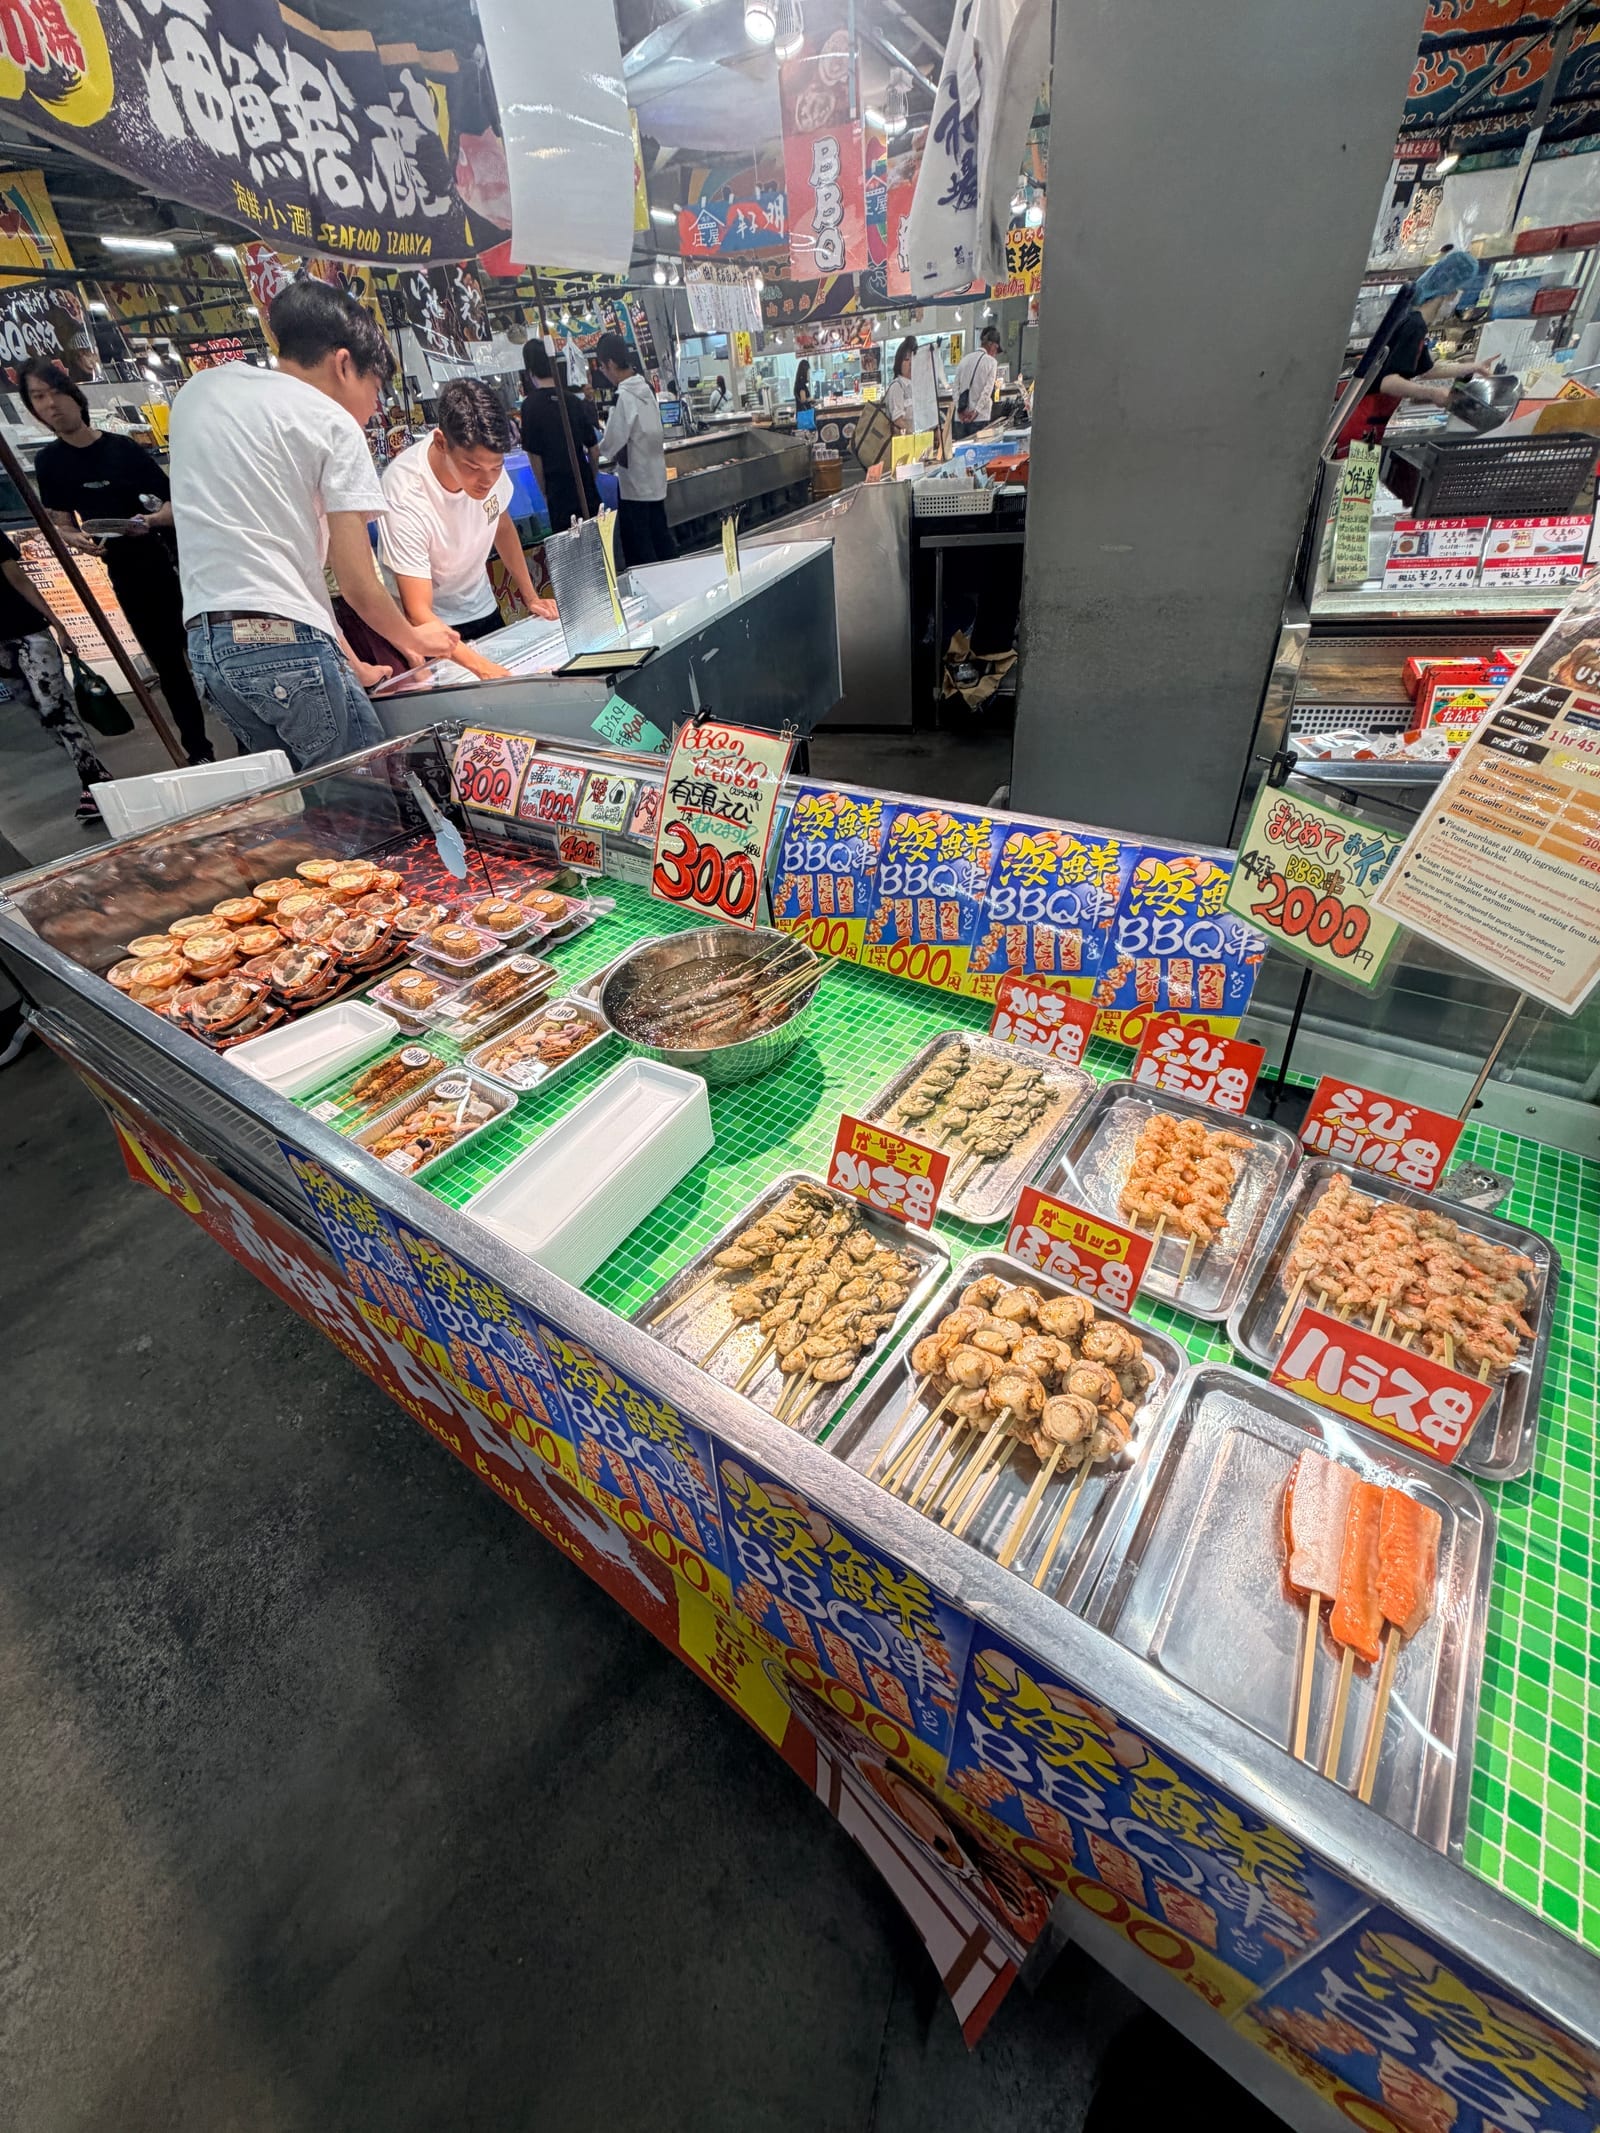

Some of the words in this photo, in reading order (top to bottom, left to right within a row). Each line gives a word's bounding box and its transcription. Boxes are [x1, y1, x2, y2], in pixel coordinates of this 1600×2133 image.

[809, 135, 845, 272] BBQ
[318, 223, 381, 252] SEAFOOD
[386, 231, 432, 256] IZAKAYA
[1542, 695, 1564, 708] hours
[682, 728, 744, 756] BBQの
[1500, 715, 1516, 727] time
[1518, 720, 1539, 734] limit
[1548, 730, 1559, 741] 1
[1560, 734, 1576, 747] hr
[1577, 739, 1597, 753] 45
[1513, 742, 1528, 755] list
[669, 776, 760, 824] 有頭えび
[1468, 773, 1489, 785] child
[791, 799, 883, 841] 海鮮
[1451, 802, 1473, 816] infant
[888, 817, 993, 862] 海鮮
[1268, 804, 1346, 860] まとめて
[1444, 819, 1469, 834] Please
[1466, 829, 1500, 848] purchase
[1500, 843, 1513, 853] all
[1511, 848, 1533, 863] BBQ
[1531, 856, 1579, 882] ingredients
[1448, 831, 1480, 849] Toretore
[783, 840, 878, 876] BBQ串
[1000, 838, 1120, 887] 海鮮
[1285, 854, 1346, 896] BBQ串
[799, 877, 813, 910] えび
[818, 874, 834, 913] ほたて
[836, 877, 854, 912] かき
[856, 880, 868, 904] など
[879, 862, 988, 899] BBQ串
[1420, 855, 1442, 869] Usage
[1440, 864, 1456, 876] time
[1467, 877, 1484, 889] hour
[1483, 885, 1497, 895] and
[1497, 891, 1507, 900] 45
[1537, 910, 1568, 930] starting
[1568, 924, 1587, 939] from
[1441, 876, 1453, 884] you
[1453, 880, 1483, 898] complete
[895, 900, 912, 936] えび
[918, 899, 936, 940] ほたて
[939, 903, 960, 940] かき
[962, 906, 974, 931] など
[987, 887, 1116, 931] BBQ串
[1494, 916, 1525, 936] purchasing
[1007, 928, 1026, 965] えび
[1034, 925, 1054, 970] ほたて
[1061, 929, 1082, 970] かき
[1114, 915, 1265, 965] BBQ串
[1136, 960, 1160, 1001] えび
[1199, 964, 1225, 1008] かき
[1230, 971, 1245, 998] など
[1010, 985, 1066, 1027] かき
[992, 1013, 1084, 1064] レモン串
[1152, 1028, 1230, 1072] えび
[1136, 1056, 1249, 1111] レモン串
[1324, 1088, 1419, 1141] えび
[855, 1131, 907, 1153] ガーリック
[885, 1147, 923, 1171] チーズ
[1301, 1120, 1441, 1186] バジル串
[832, 1150, 935, 1224] かき串
[1038, 1207, 1124, 1255] ガーリック
[1009, 1224, 1133, 1310] ほたて串
[1281, 1327, 1473, 1449] ハラス串
[382, 1374, 462, 1453] Seafood
[474, 1451, 585, 1561] Barbecue
[719, 1463, 945, 1641] 海鮮
[728, 1522, 959, 1701] BBQ串
[974, 1652, 1308, 1892] 海鮮
[966, 1709, 1308, 1951] BBQ串
